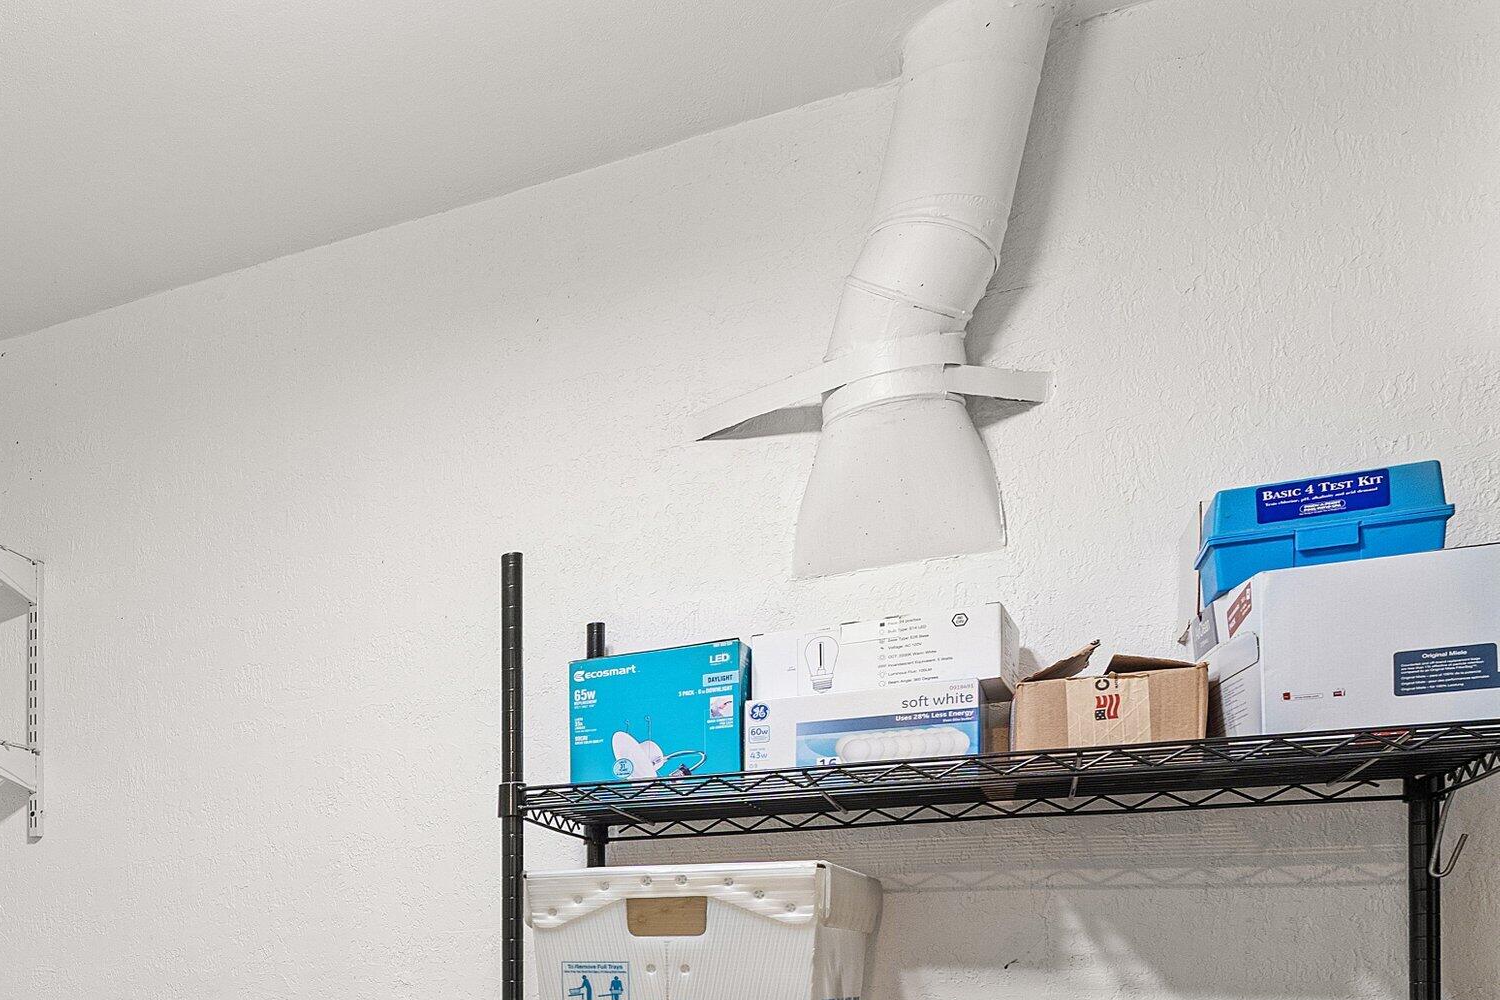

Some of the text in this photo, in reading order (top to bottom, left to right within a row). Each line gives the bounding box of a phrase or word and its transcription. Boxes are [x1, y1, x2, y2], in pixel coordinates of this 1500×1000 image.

[1262, 475, 1384, 501] BASIC 4 TEST KIT
[709, 653, 730, 664] LED
[585, 664, 637, 680] ecosmart
[707, 674, 733, 683] DAYLIGHT
[901, 691, 974, 709] soft white
[895, 709, 974, 722] Uses 28% Less Energy
